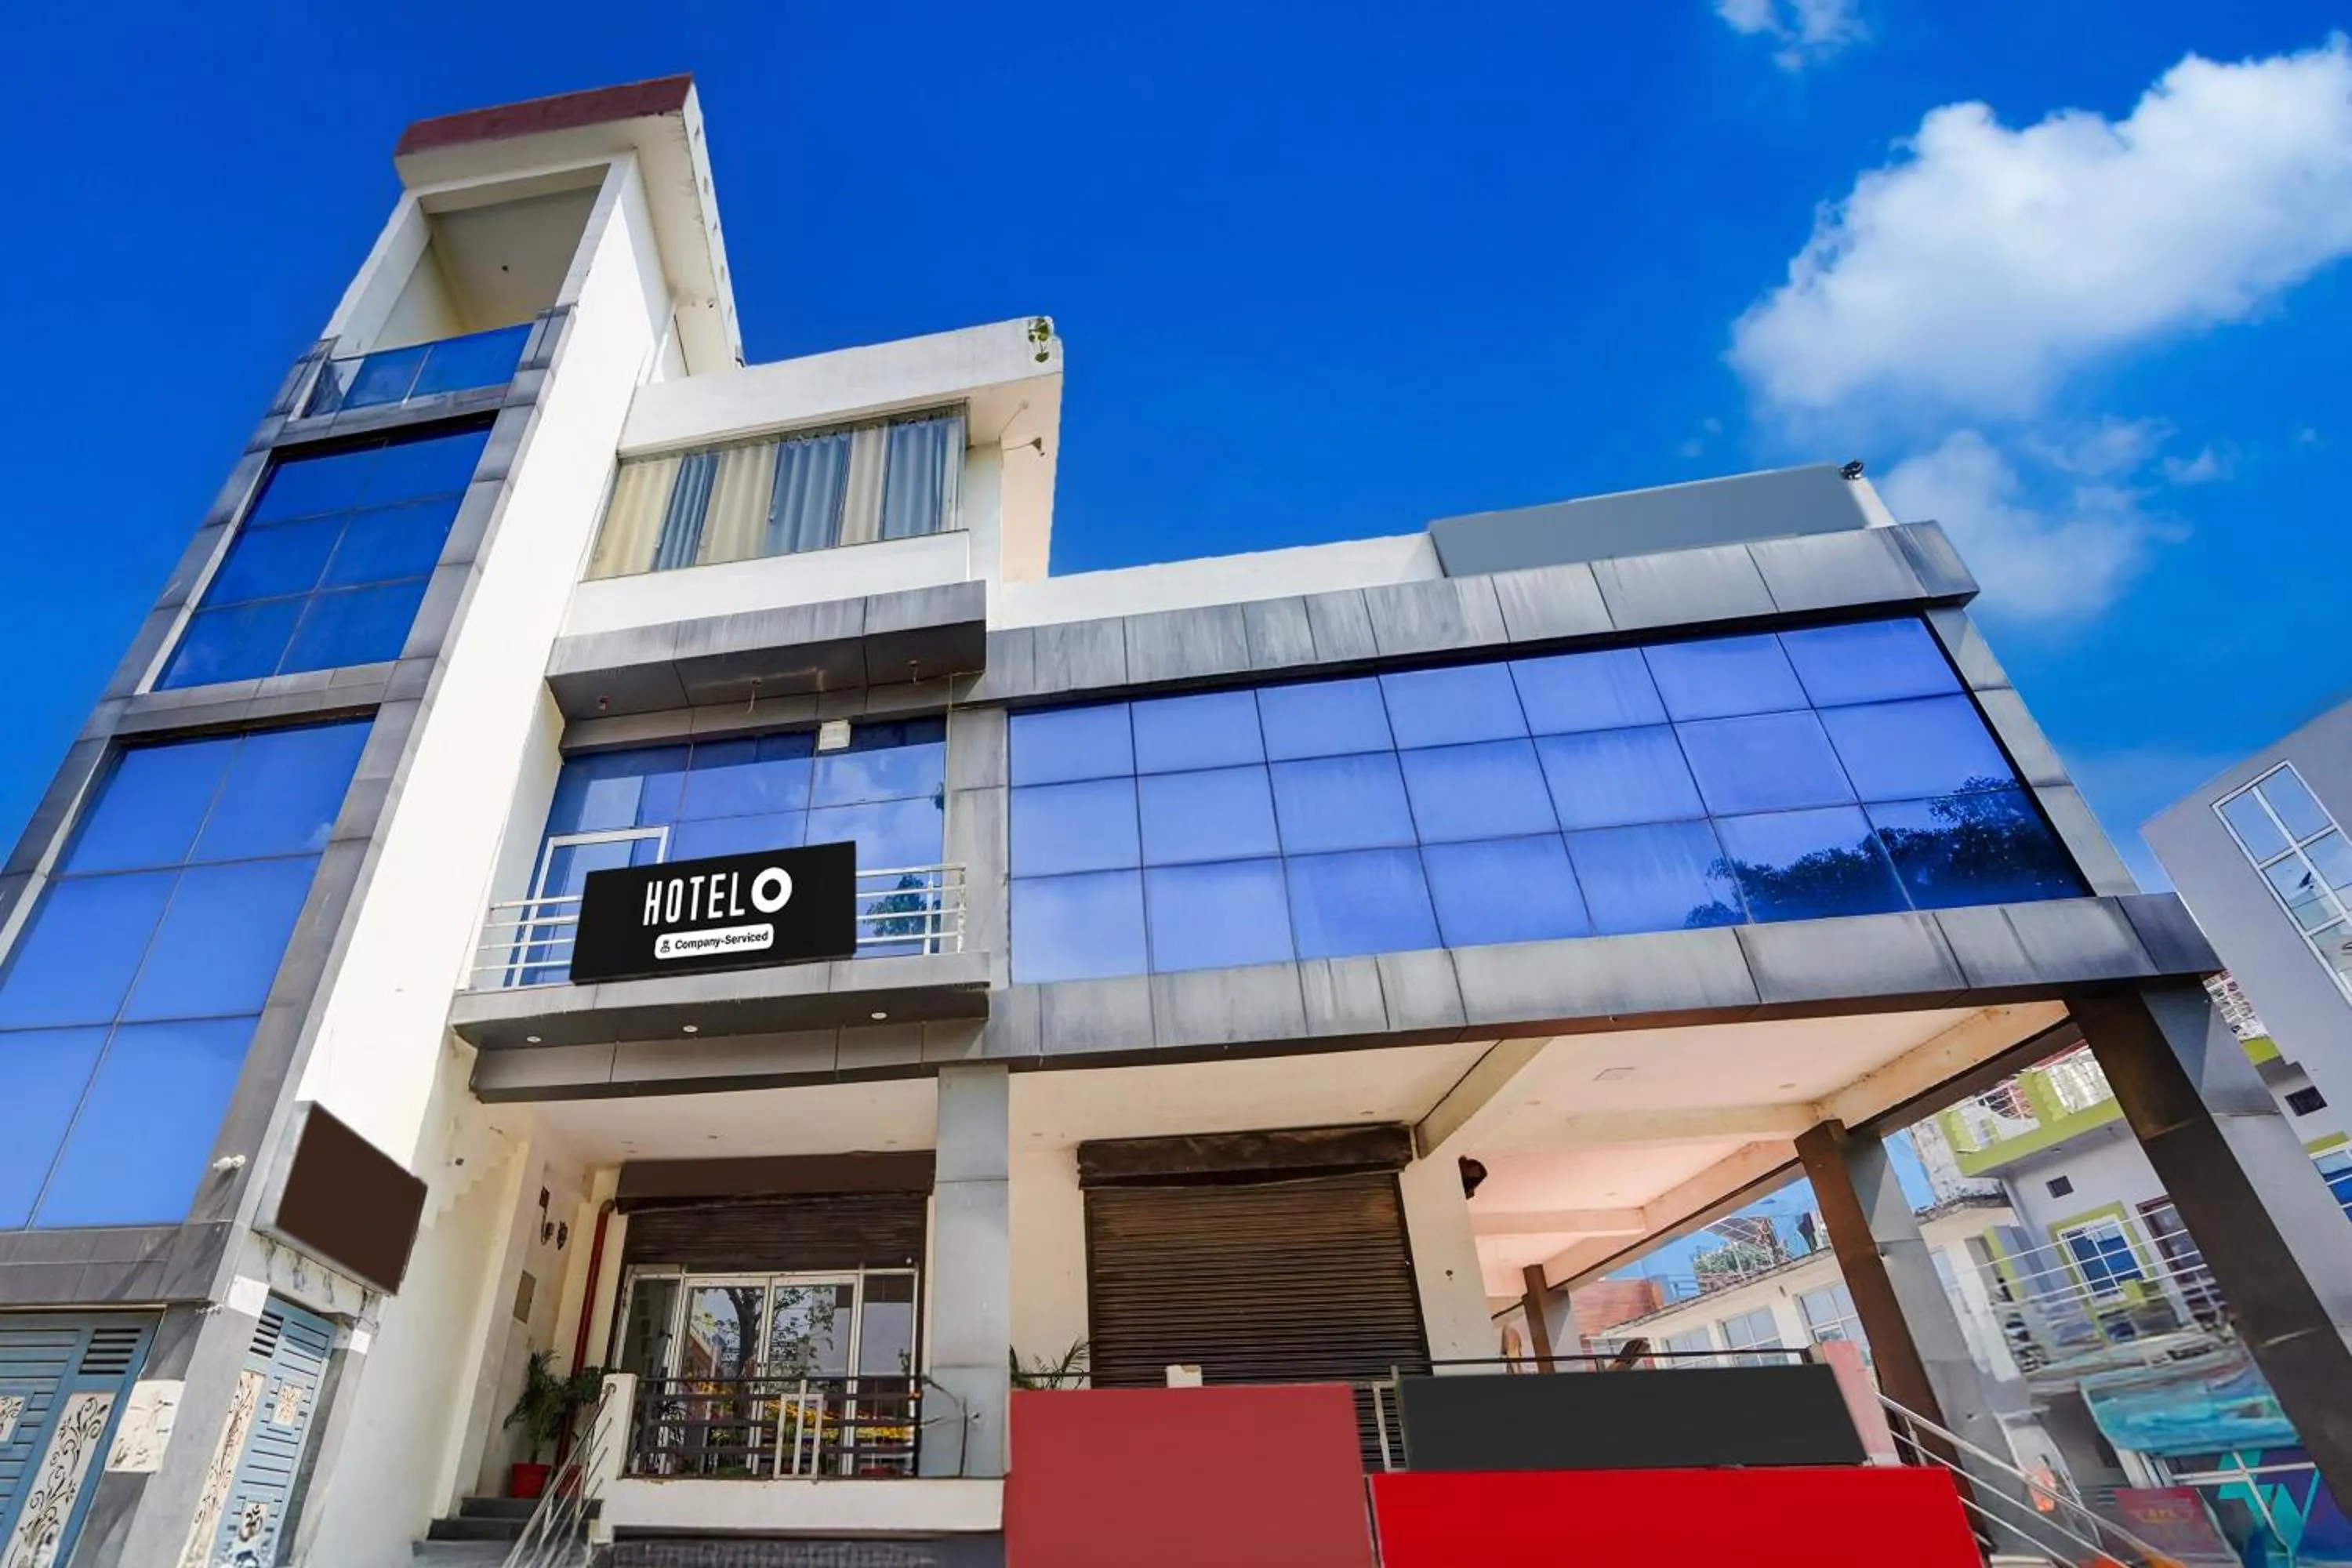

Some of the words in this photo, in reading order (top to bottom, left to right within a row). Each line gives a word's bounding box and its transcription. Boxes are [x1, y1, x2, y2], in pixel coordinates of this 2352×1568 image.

[643, 871, 746, 926] HOTEL
[751, 866, 793, 913] O
[674, 930, 769, 950] Company-Serviced
